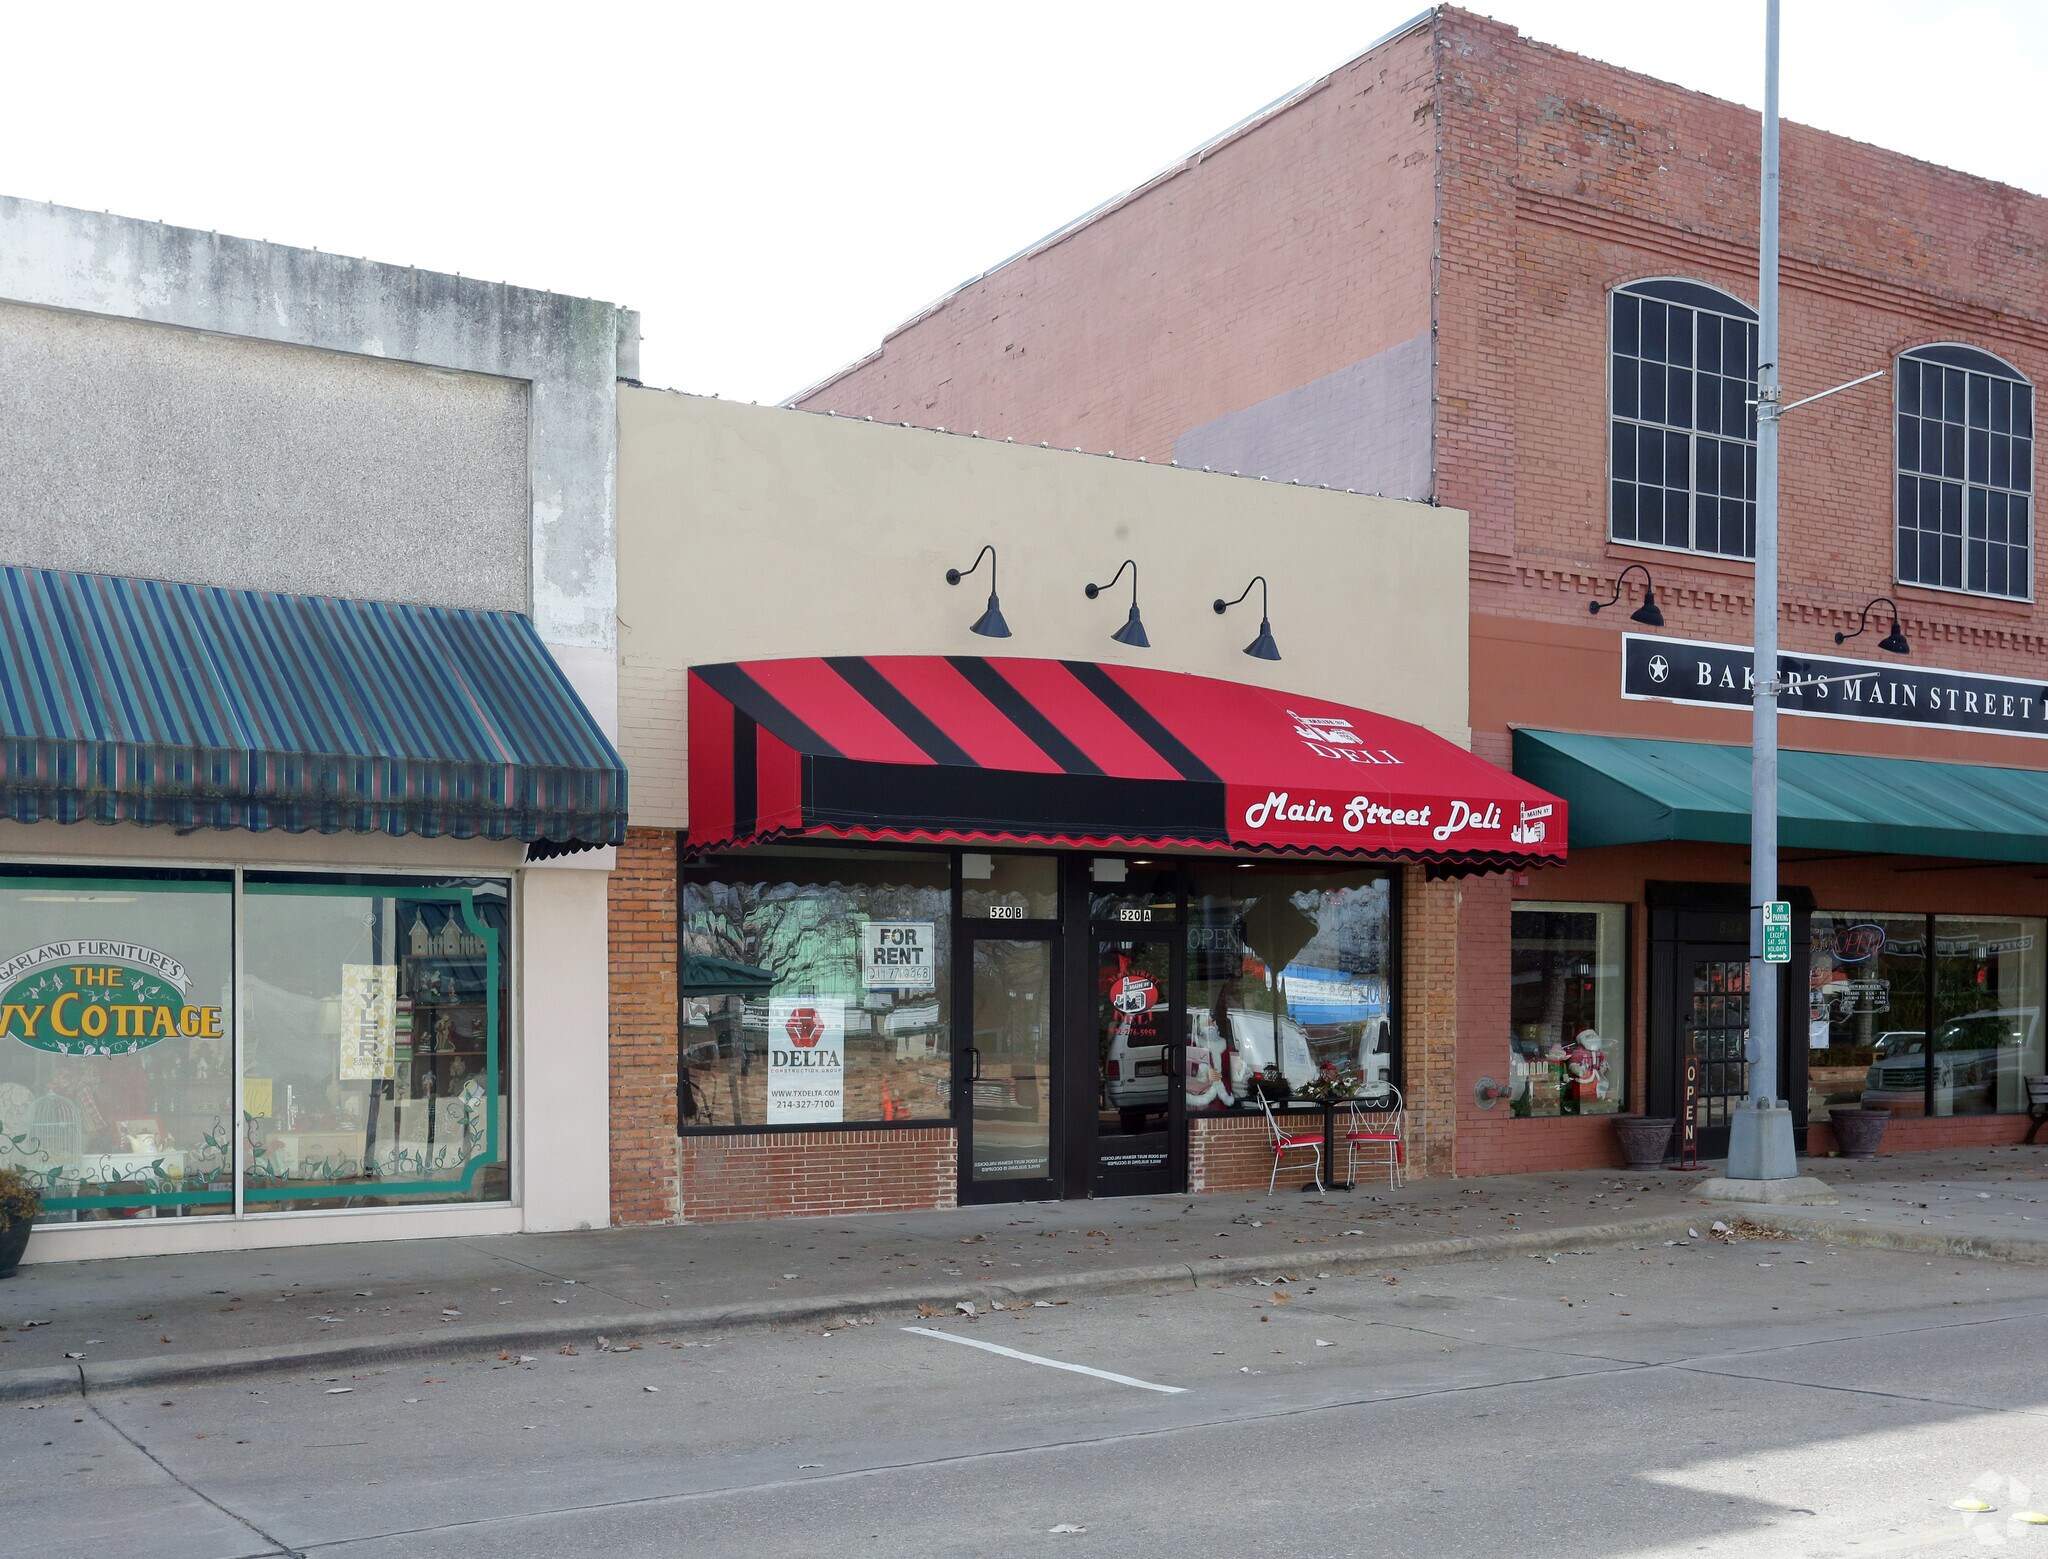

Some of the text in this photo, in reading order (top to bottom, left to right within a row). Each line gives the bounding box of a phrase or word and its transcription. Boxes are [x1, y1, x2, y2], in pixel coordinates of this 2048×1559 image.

[1843, 679, 1917, 707] MAIN
[1929, 686, 2034, 719] STREET
[1301, 740, 1404, 765] DELI
[1245, 791, 1501, 841] Main Street Deli
[1527, 809, 1542, 818] MAIN
[991, 907, 1022, 918] 520 B
[1121, 910, 1151, 921] 520 A
[1765, 905, 1771, 920] 3
[1773, 914, 1788, 922] PARKING
[880, 928, 917, 946] FOR
[1188, 928, 1241, 950] OPEN
[1834, 929, 1882, 957] OPEN
[0, 941, 182, 980] GARLAND FURNITURE'S
[873, 947, 924, 965] RENT
[69, 967, 125, 987] THE
[51, 991, 225, 1039] COTTAGE
[358, 978, 380, 1057] TYLER
[1113, 1009, 1153, 1026] DELI
[771, 1050, 841, 1067] DELTA
[771, 1089, 840, 1098] WWW.TXDELTA.COM
[1685, 1065, 1696, 1140] OPEN
[776, 1099, 835, 1109] 214-327-7100
